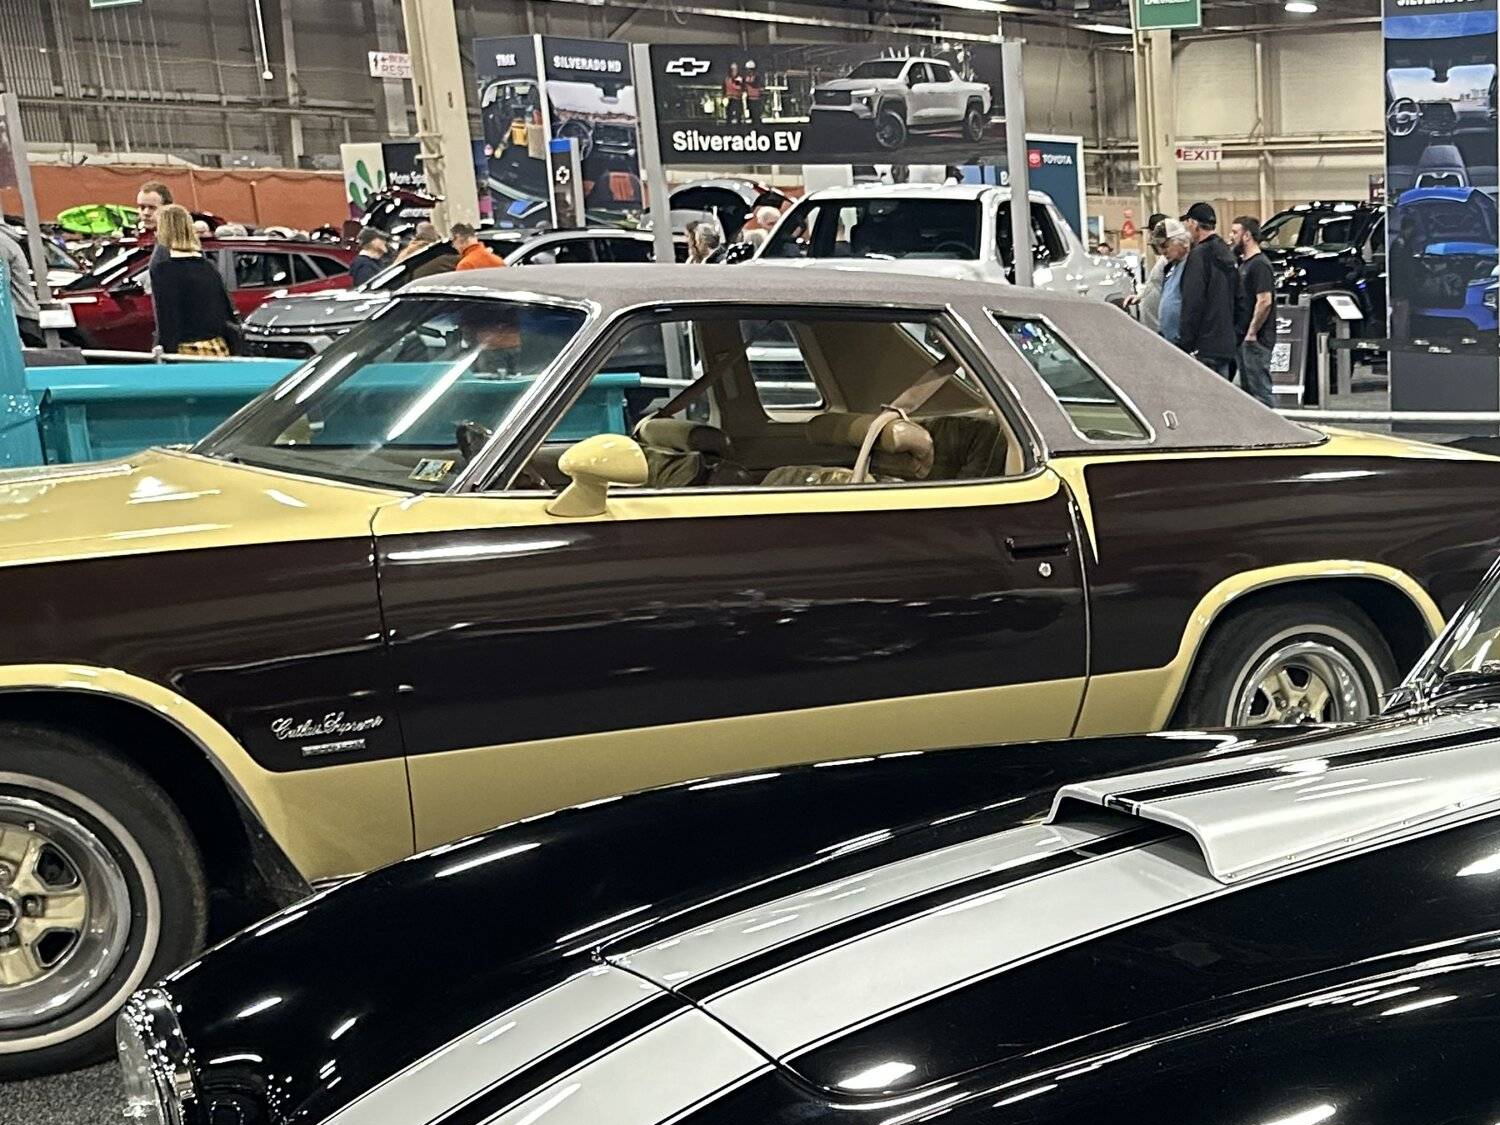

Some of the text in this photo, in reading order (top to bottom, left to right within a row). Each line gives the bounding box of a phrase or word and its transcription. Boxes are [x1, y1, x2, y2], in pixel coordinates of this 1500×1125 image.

[553, 55, 606, 72] SILVERADO
[672, 130, 802, 152] Silverado EV
[1042, 153, 1073, 165] TOYOTA
[1183, 150, 1219, 161] EXIT
[271, 711, 384, 741] Cutlass Supreme
